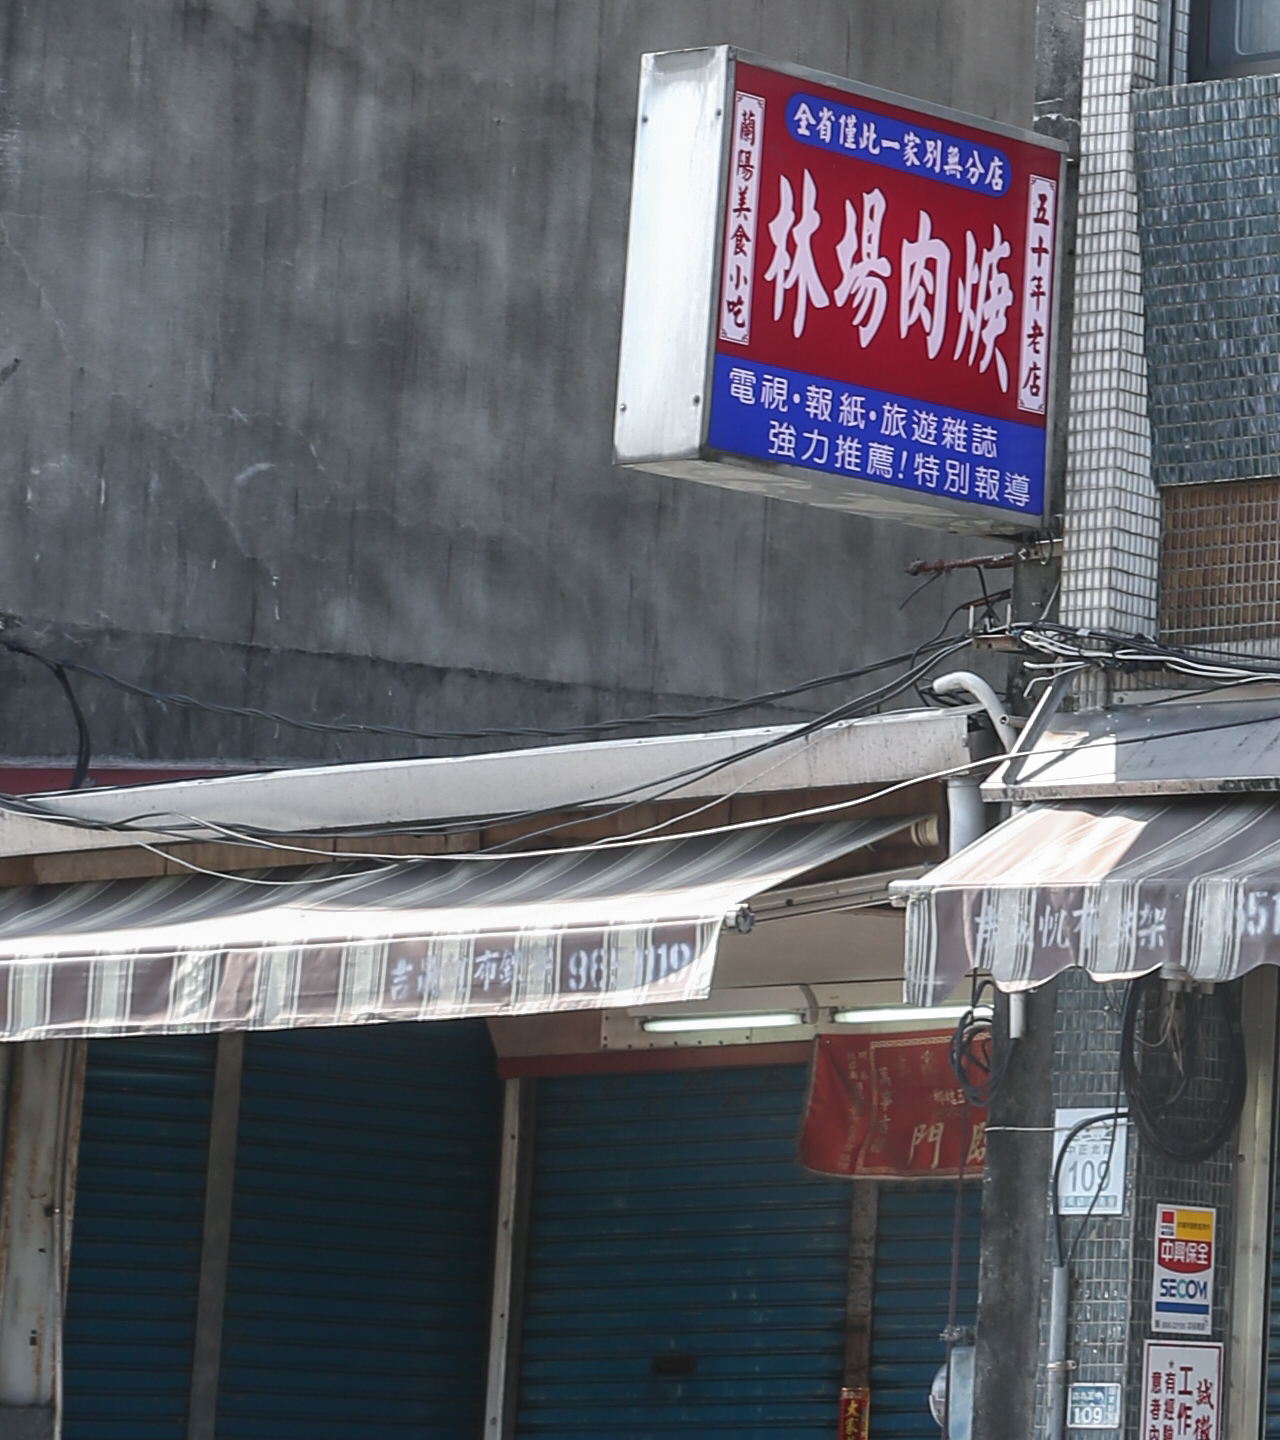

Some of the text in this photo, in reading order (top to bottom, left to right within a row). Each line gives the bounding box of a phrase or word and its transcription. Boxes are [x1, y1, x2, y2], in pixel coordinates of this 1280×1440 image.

[794, 103, 1004, 193] 全省僅此一家別無分店
[726, 109, 757, 329] 蘭陽美食小吃
[765, 168, 1014, 393] 林場肉焿
[1022, 194, 1051, 397] 五十年老店
[1068, 1160, 1112, 1193] 109
[1161, 1240, 1209, 1264] 中興保全
[1159, 1278, 1208, 1299] SECOM
[1074, 1406, 1104, 1424] 109
